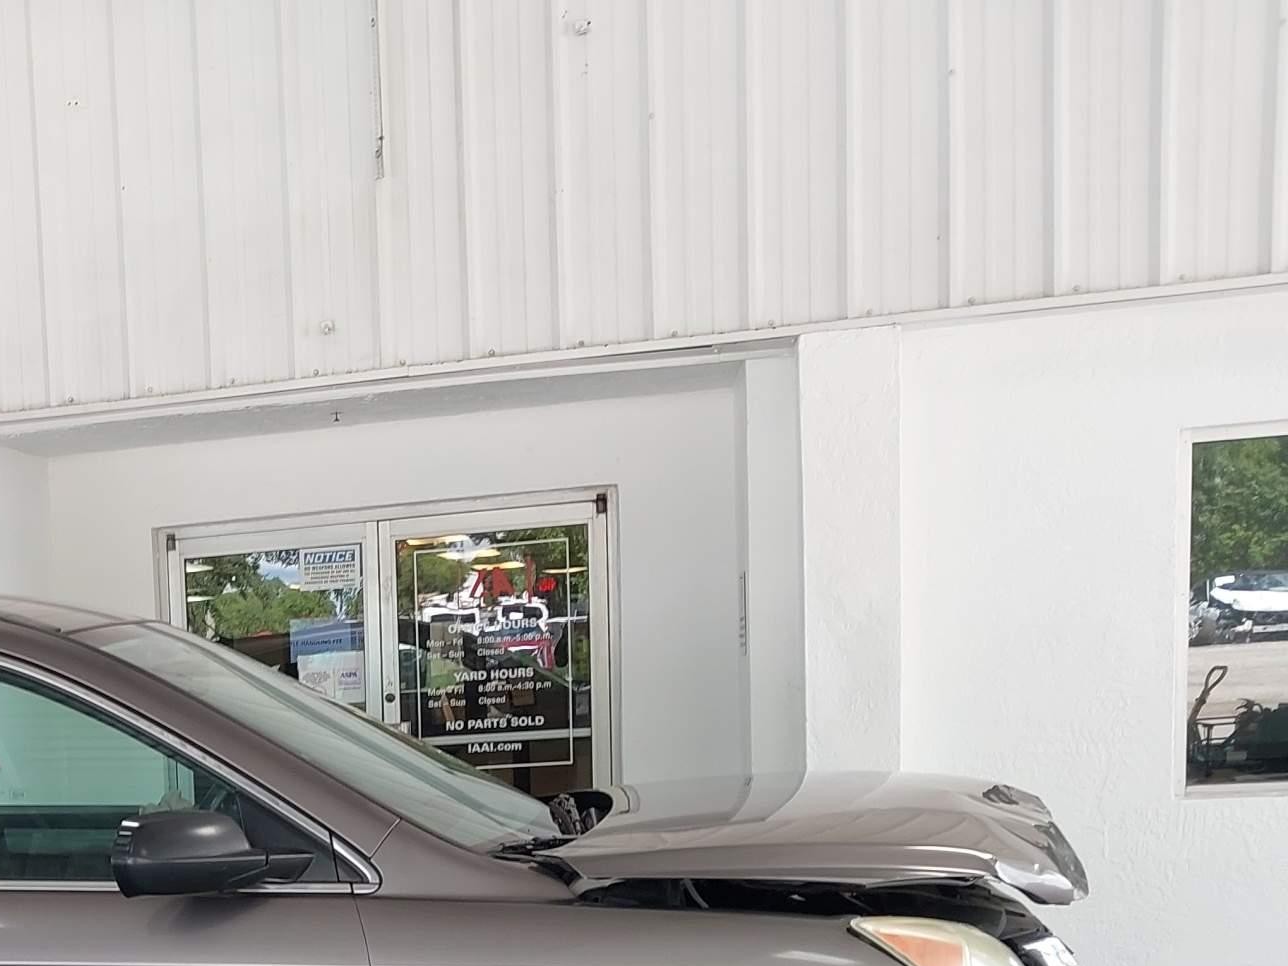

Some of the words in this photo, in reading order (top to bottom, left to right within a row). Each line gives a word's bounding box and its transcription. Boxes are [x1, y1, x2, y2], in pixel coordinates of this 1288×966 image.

[305, 550, 354, 564] NOTICE
[494, 617, 537, 631] HOURS
[426, 639, 444, 649] Mon
[448, 650, 465, 659] Sun
[476, 647, 505, 657] Closed
[454, 669, 488, 682] YARD
[490, 667, 534, 680] HOURS
[450, 697, 466, 707] Sun
[478, 695, 506, 706] Closed
[445, 719, 465, 732] NO
[467, 717, 508, 730] PARTS
[510, 715, 545, 727] SOLD
[467, 741, 523, 754] IAAI.com
